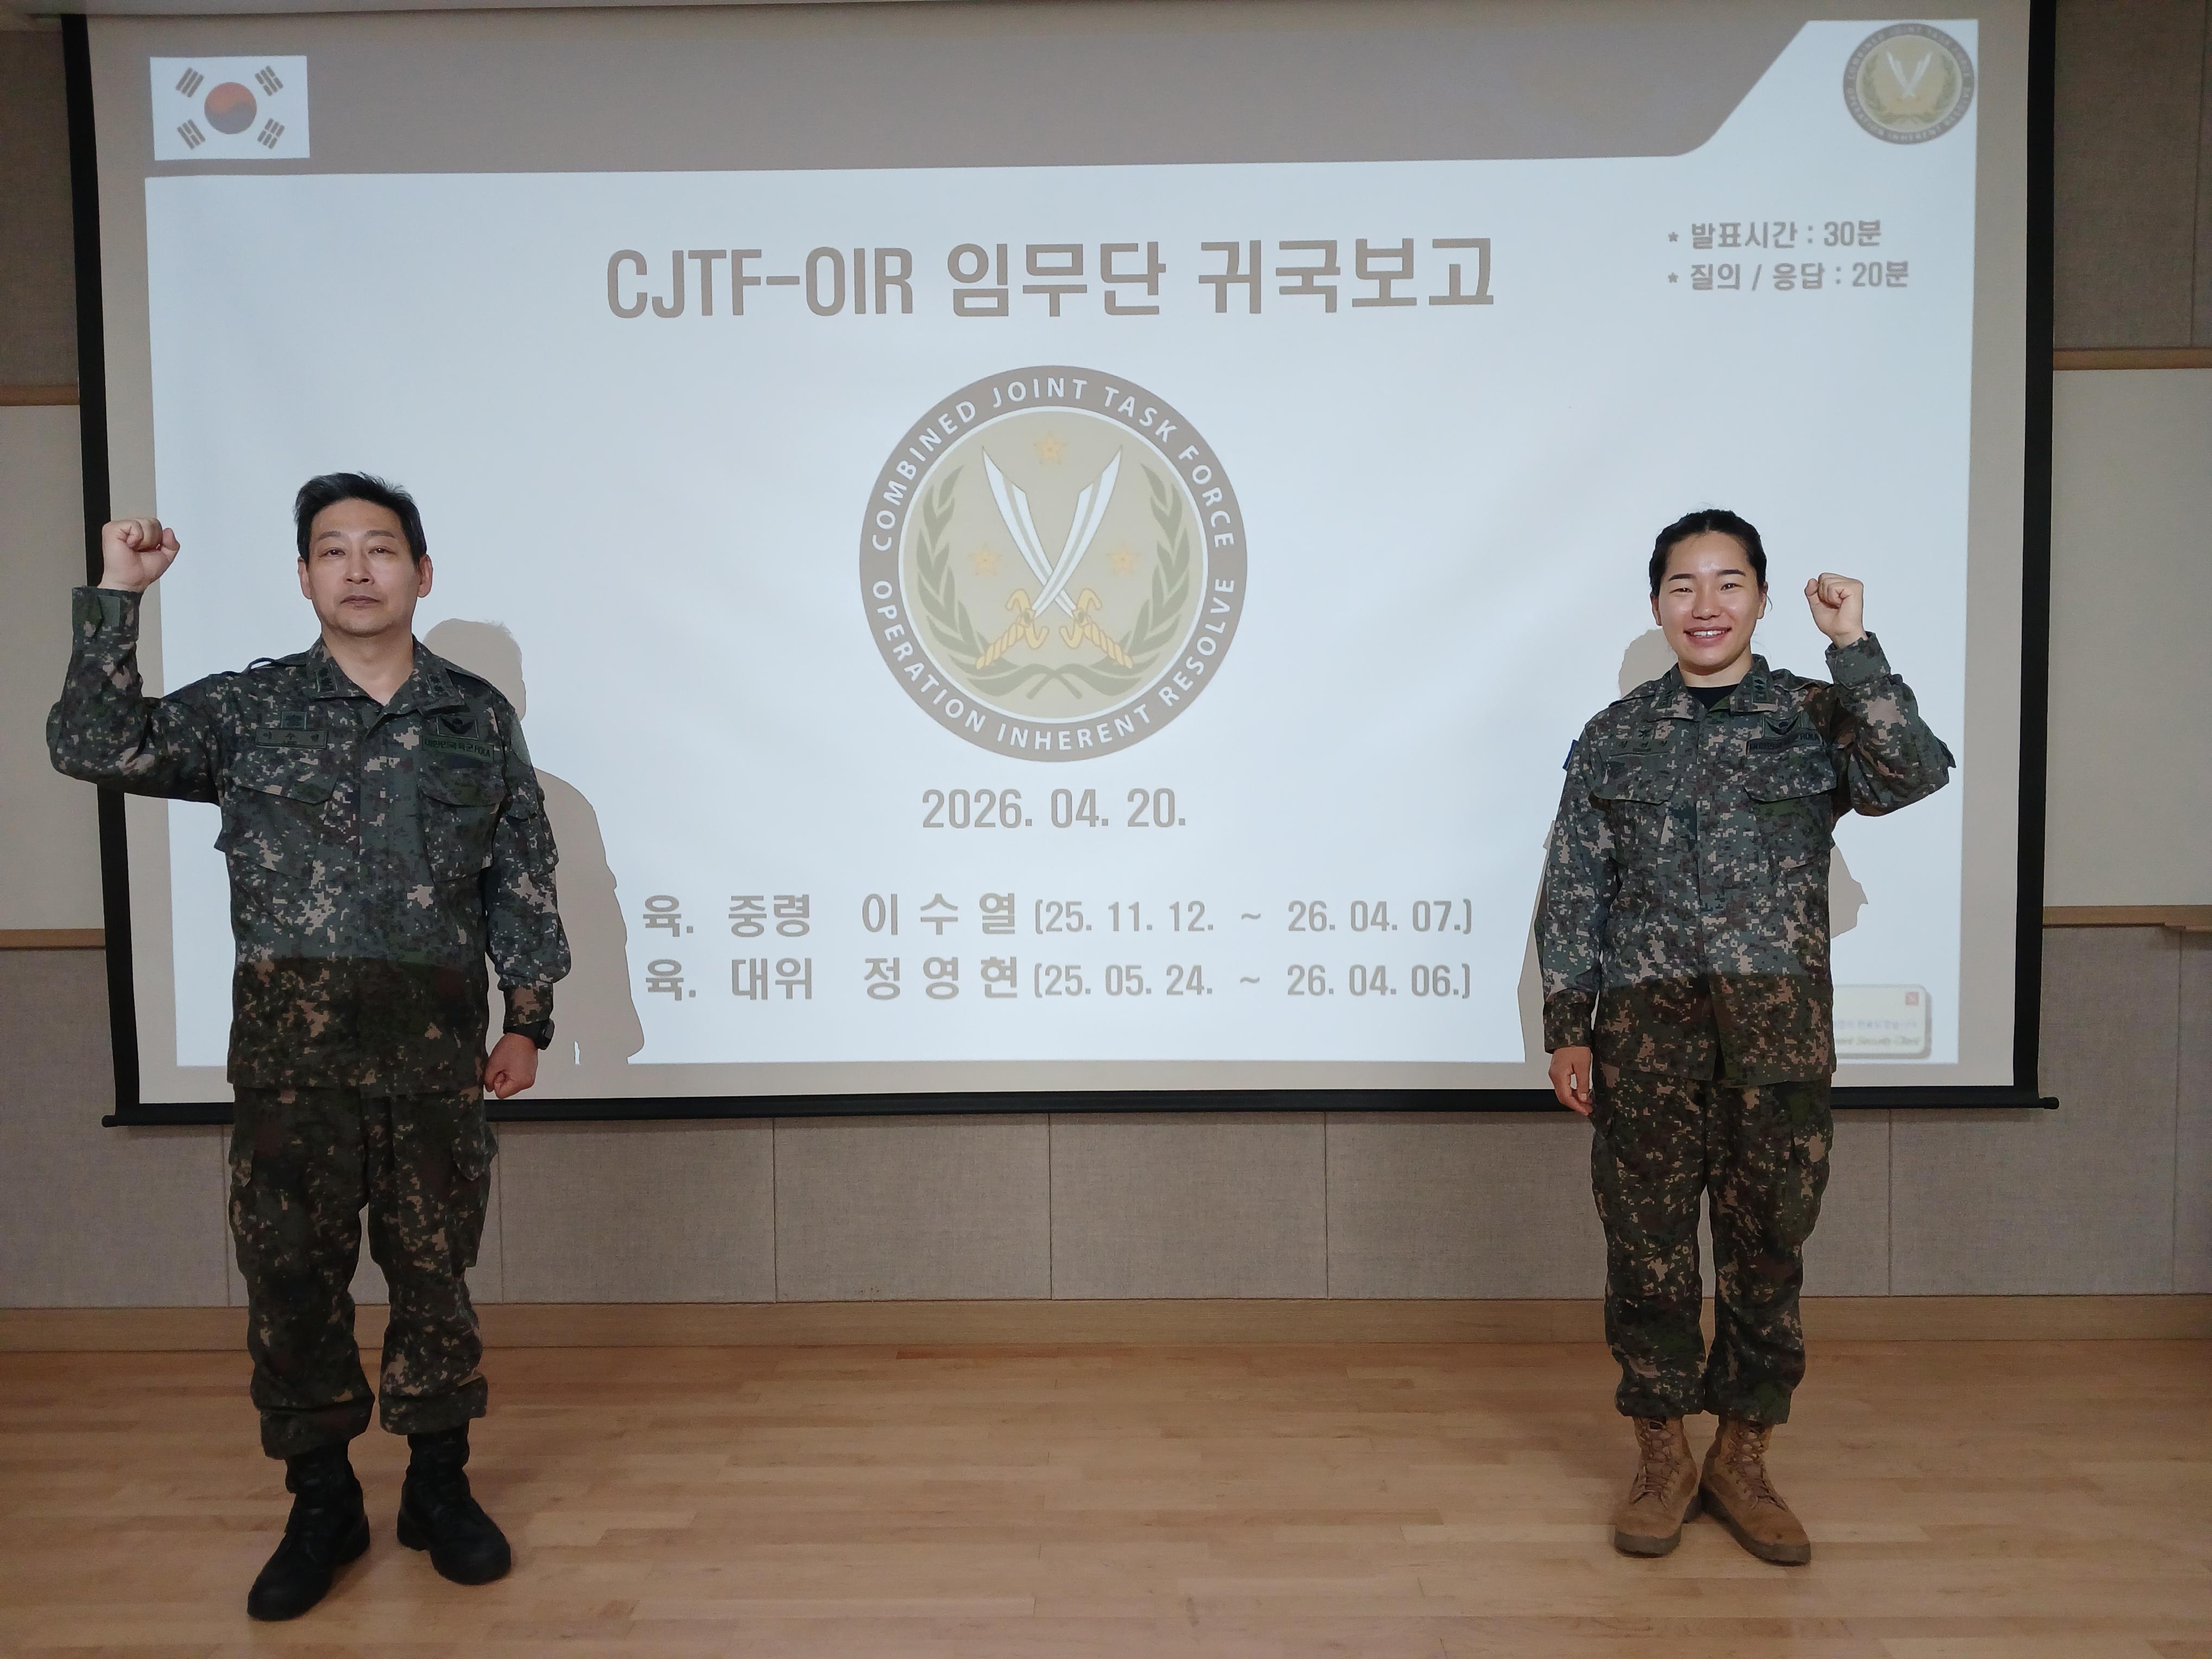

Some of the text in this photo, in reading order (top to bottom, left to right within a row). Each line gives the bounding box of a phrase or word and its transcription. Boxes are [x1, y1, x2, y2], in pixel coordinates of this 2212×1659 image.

[1692, 222, 1797, 249] 발표시간
[1824, 220, 1881, 246] 30분
[607, 238, 1494, 318] CJTF-OIR 임무단 귀국보고
[1691, 263, 1740, 290] 질의
[1773, 263, 1825, 291] 응답
[1853, 261, 1908, 287] 20분
[872, 377, 1234, 551] COMBINED JOINT TASK FORCE
[872, 578, 1234, 750] OPERATION INHERENT RESOLVE
[923, 788, 1185, 828] 2026. 04. 20.
[643, 895, 693, 937] 육.
[729, 895, 809, 937] 중령
[863, 893, 898, 935] 이
[921, 893, 958, 935] 수
[979, 893, 1015, 934] 열
[1036, 899, 1091, 934] (25.
[1108, 902, 1152, 931] 11.
[1169, 901, 1213, 931] 12.
[1288, 901, 1335, 931] 26.
[1351, 901, 1397, 931] 04.
[1413, 899, 1471, 934] 07.)
[646, 959, 696, 1001] 육.
[732, 958, 812, 1000] 대위
[864, 957, 900, 1000] 정
[923, 957, 959, 1000] 영
[981, 956, 1017, 998] 현
[1034, 963, 1091, 998] (25.
[1105, 965, 1152, 995] 05.
[1166, 964, 1212, 995] 24.
[1288, 964, 1334, 996] 26.
[1349, 964, 1396, 996] 04.
[1412, 963, 1470, 999] 06.)
